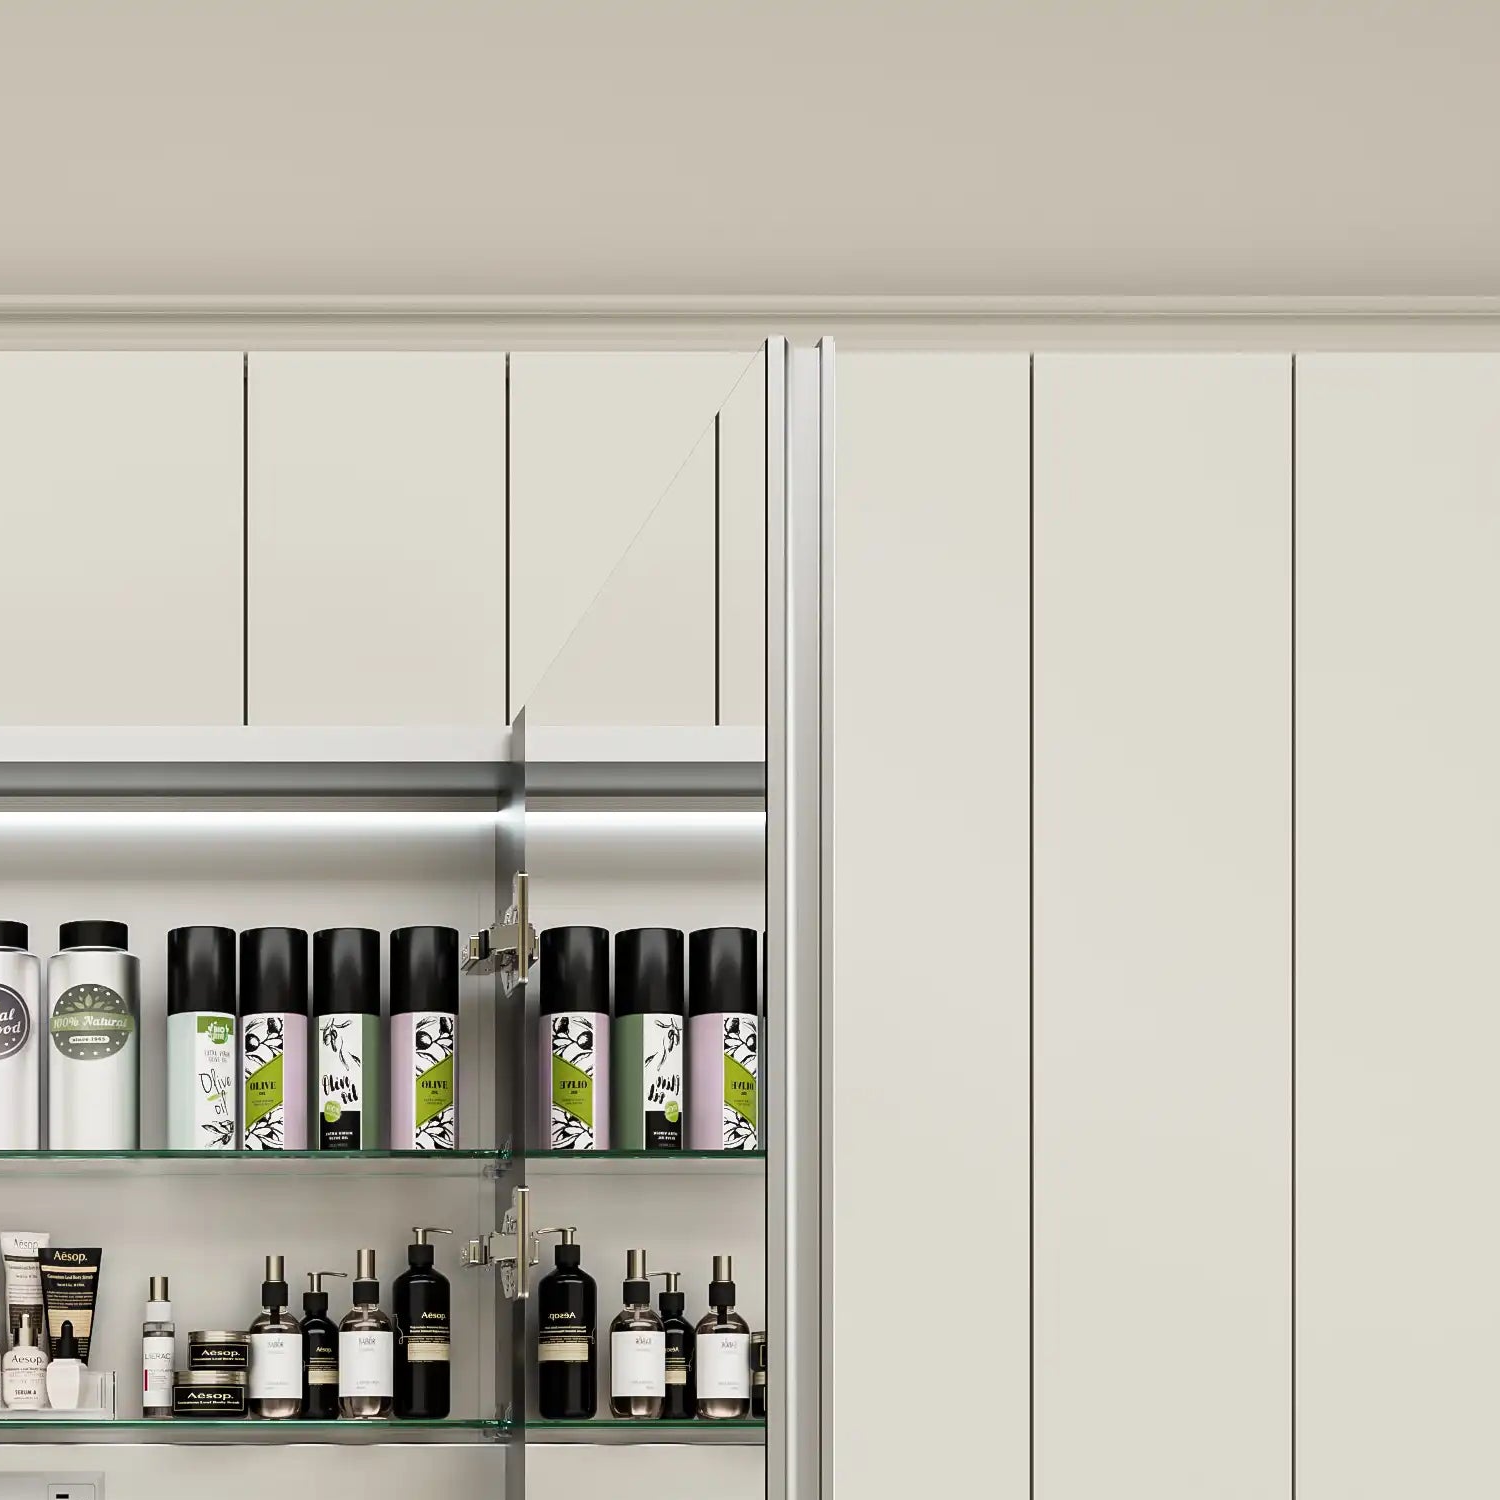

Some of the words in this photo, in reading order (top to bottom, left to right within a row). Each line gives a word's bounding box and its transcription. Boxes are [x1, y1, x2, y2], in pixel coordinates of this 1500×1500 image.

[53, 1016, 80, 1029] 100%
[82, 1015, 128, 1029] Natural
[199, 1068, 232, 1094] Olive
[250, 1081, 276, 1090] OLIVE
[322, 1074, 351, 1096] Olive
[421, 1080, 448, 1089] OLIVE
